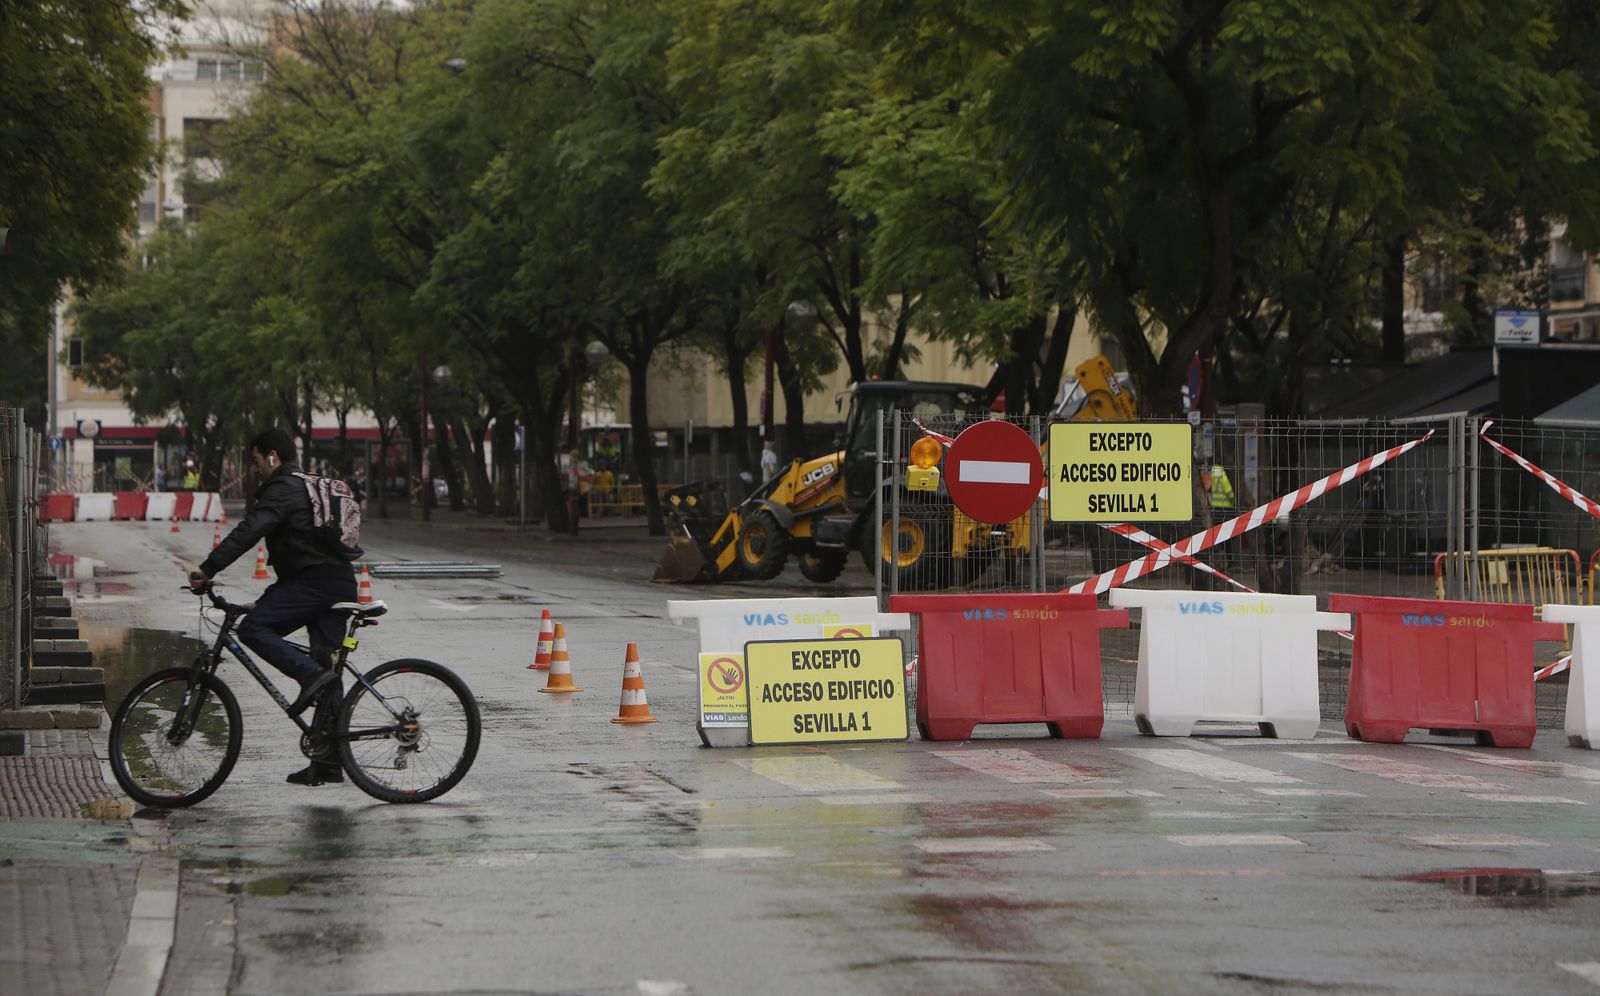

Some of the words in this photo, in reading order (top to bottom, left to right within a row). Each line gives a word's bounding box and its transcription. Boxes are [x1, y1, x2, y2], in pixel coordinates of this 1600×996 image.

[1089, 432, 1152, 451] EXCEPTO
[804, 463, 835, 486] JCB
[1060, 463, 1117, 483] ACCESO
[1121, 462, 1181, 482] EDIFICIO
[1088, 494, 1146, 513] SEVILLA
[1150, 493, 1159, 512] 1
[743, 613, 789, 626] VIAS
[794, 608, 841, 625] sando
[962, 607, 1008, 621] VIAS
[1013, 604, 1059, 620] sando
[1178, 601, 1224, 615] VIAS
[1228, 600, 1274, 616] sando
[1401, 613, 1446, 626] VIAS
[1449, 613, 1495, 628] sando
[792, 648, 861, 671] EXCEPTO
[762, 681, 823, 703] ACCESO
[828, 679, 895, 701] EDIFICIO
[793, 712, 857, 734] SEVILLA
[862, 711, 871, 731] 1
